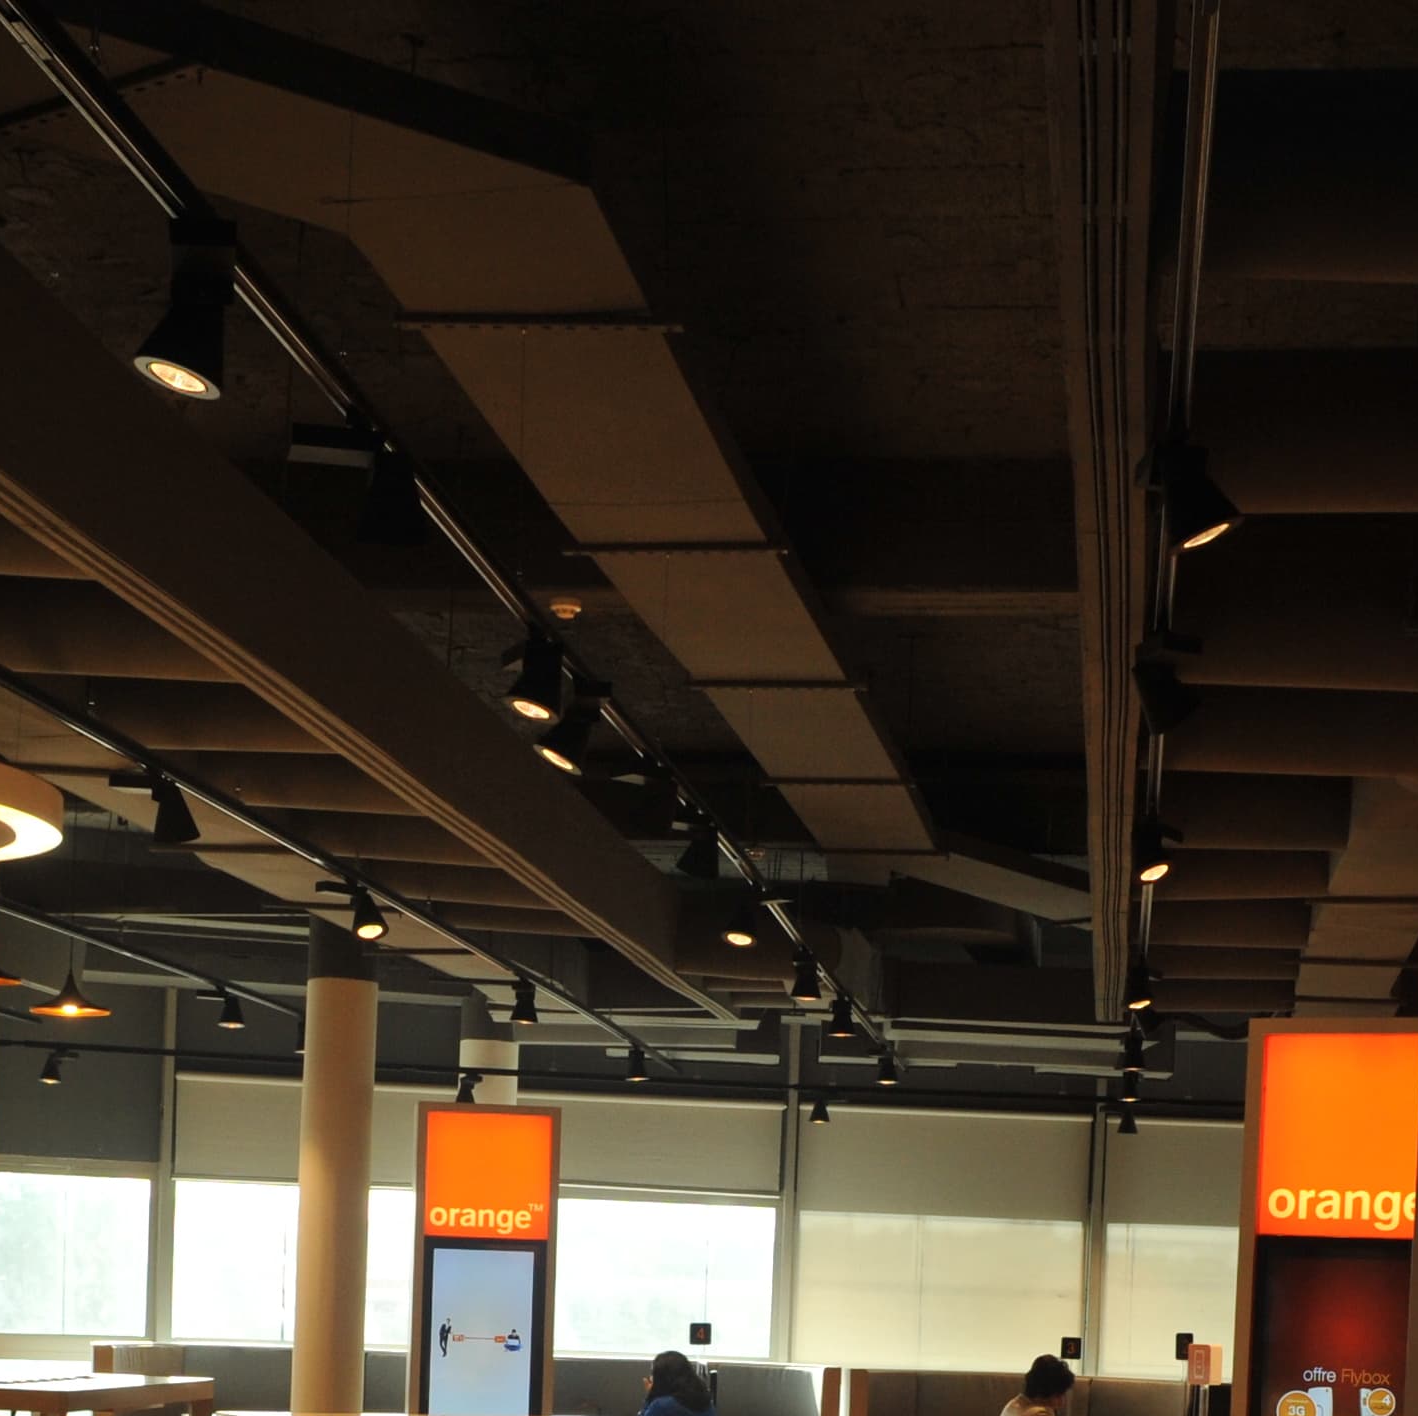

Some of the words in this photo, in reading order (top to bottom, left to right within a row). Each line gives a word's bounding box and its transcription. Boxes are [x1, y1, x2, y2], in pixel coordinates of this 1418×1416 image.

[430, 1206, 532, 1234] orange
[1303, 1367, 1337, 1383] offre
[1341, 1368, 1391, 1387] Flybox
[1288, 1405, 1306, 1416] 3G
